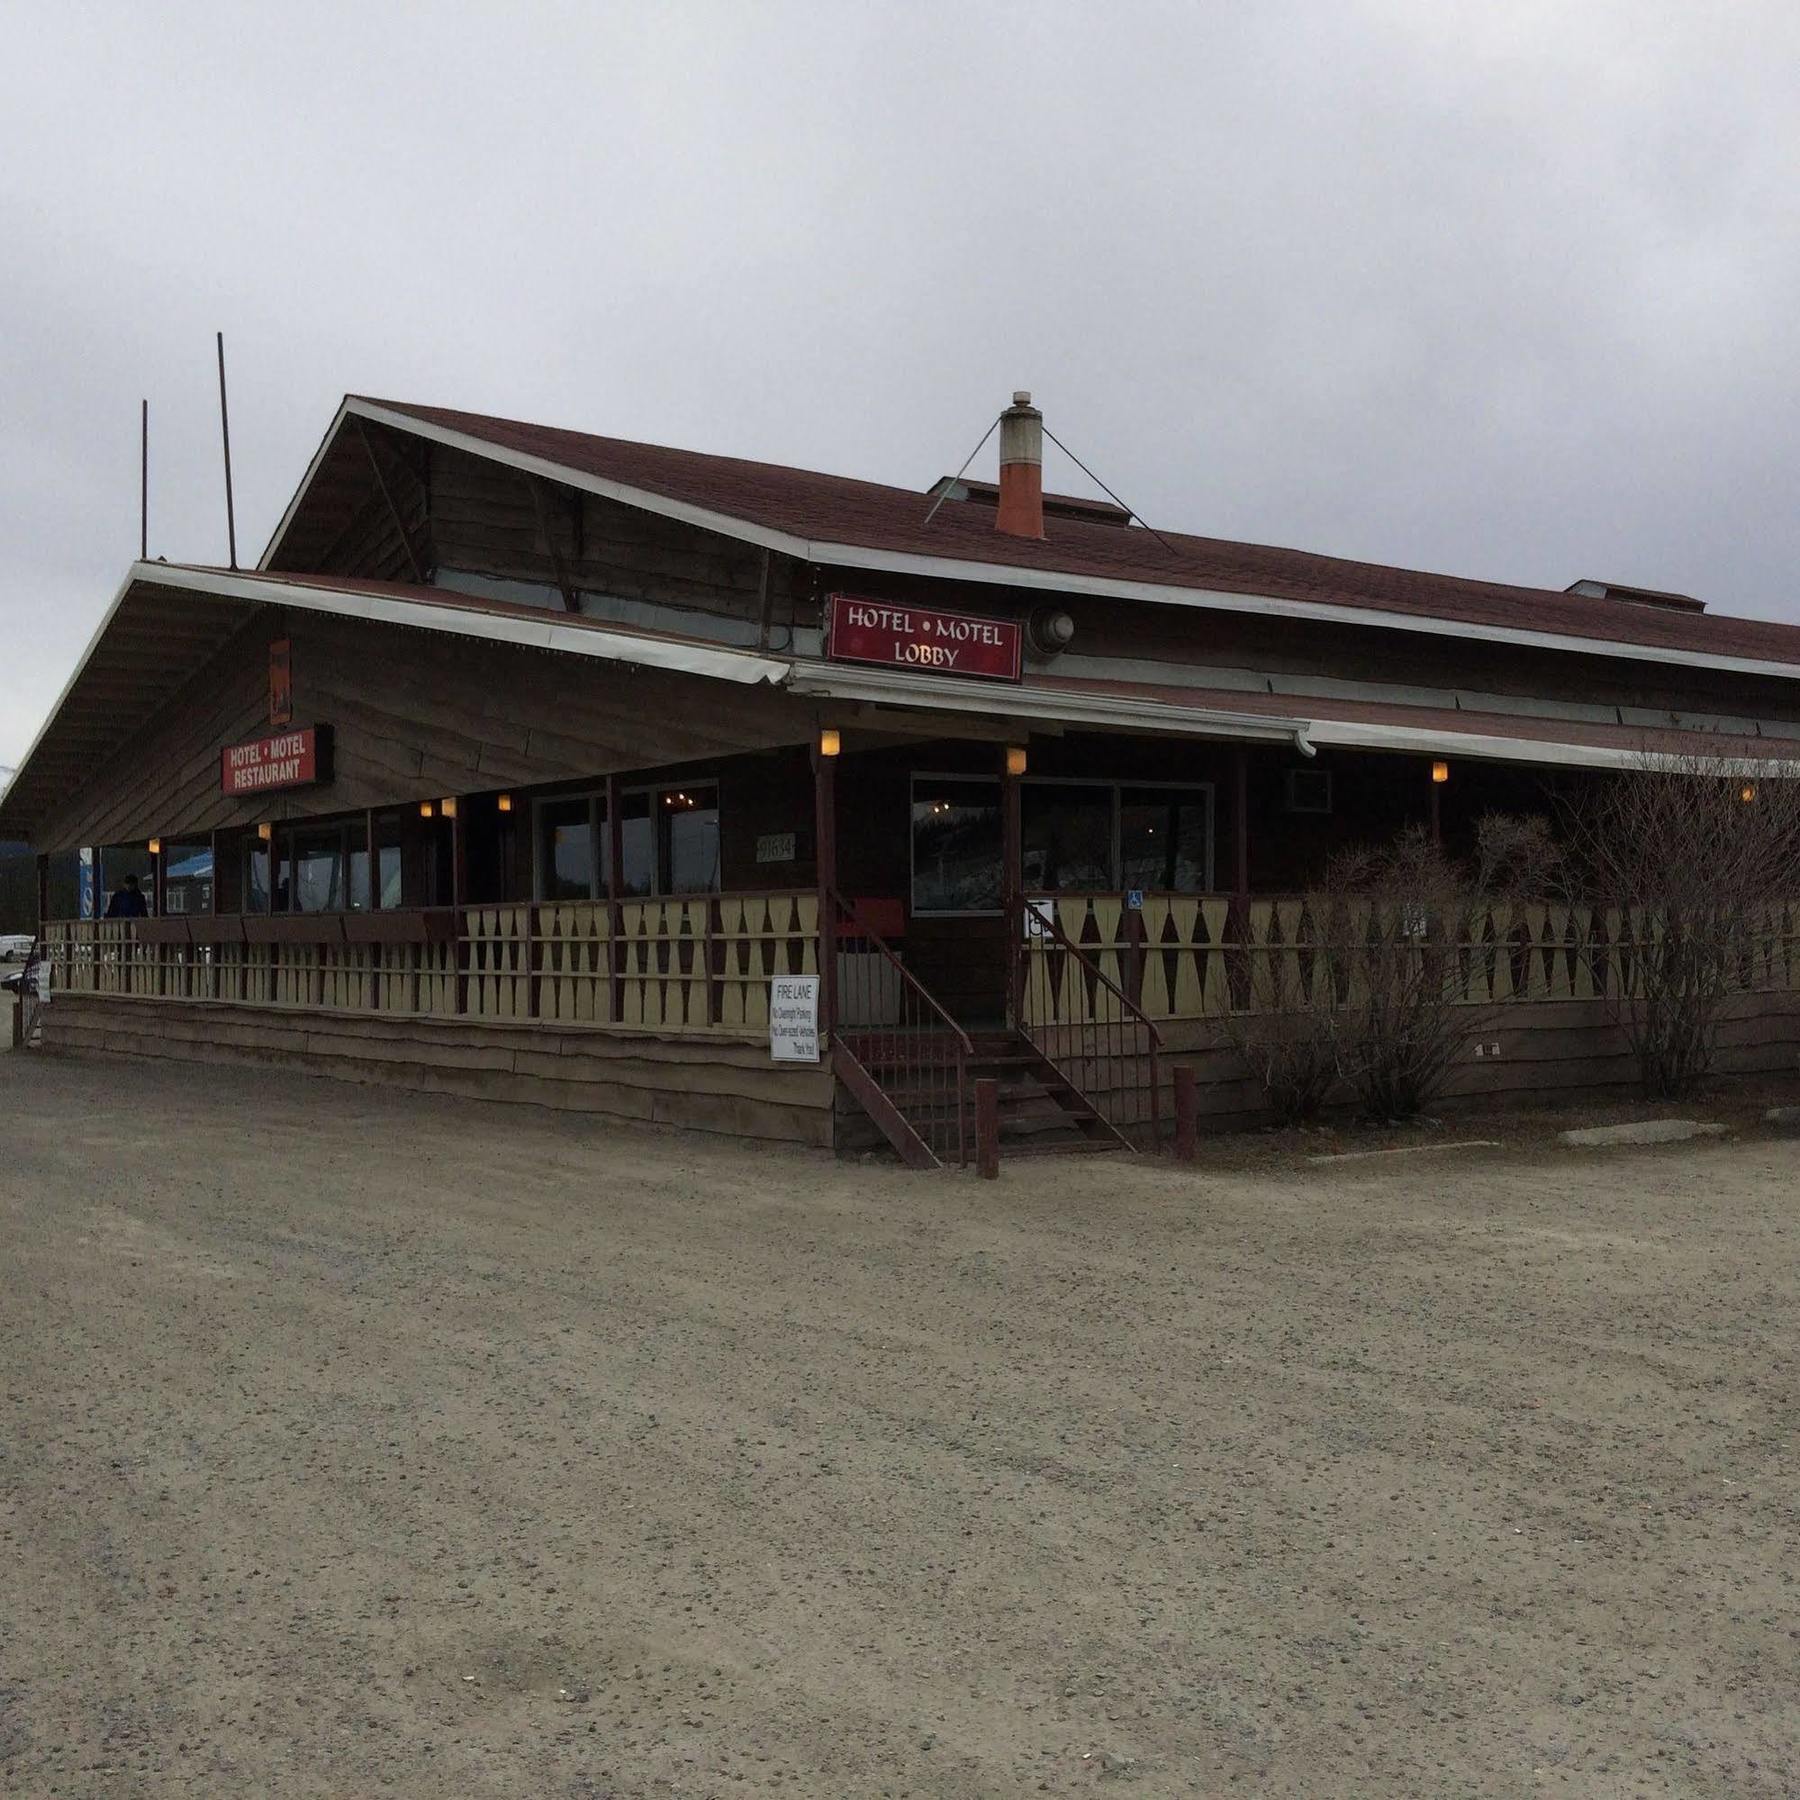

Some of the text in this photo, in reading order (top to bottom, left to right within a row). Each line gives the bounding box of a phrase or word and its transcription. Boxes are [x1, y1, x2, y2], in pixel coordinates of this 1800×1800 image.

[848, 606, 1003, 646] HOTEL MOTEL
[894, 641, 959, 668] LOBBY
[231, 734, 305, 767] HOTEL MOTEL
[234, 758, 300, 789] RESTAURANT
[777, 984, 812, 999] FIRE LANE
